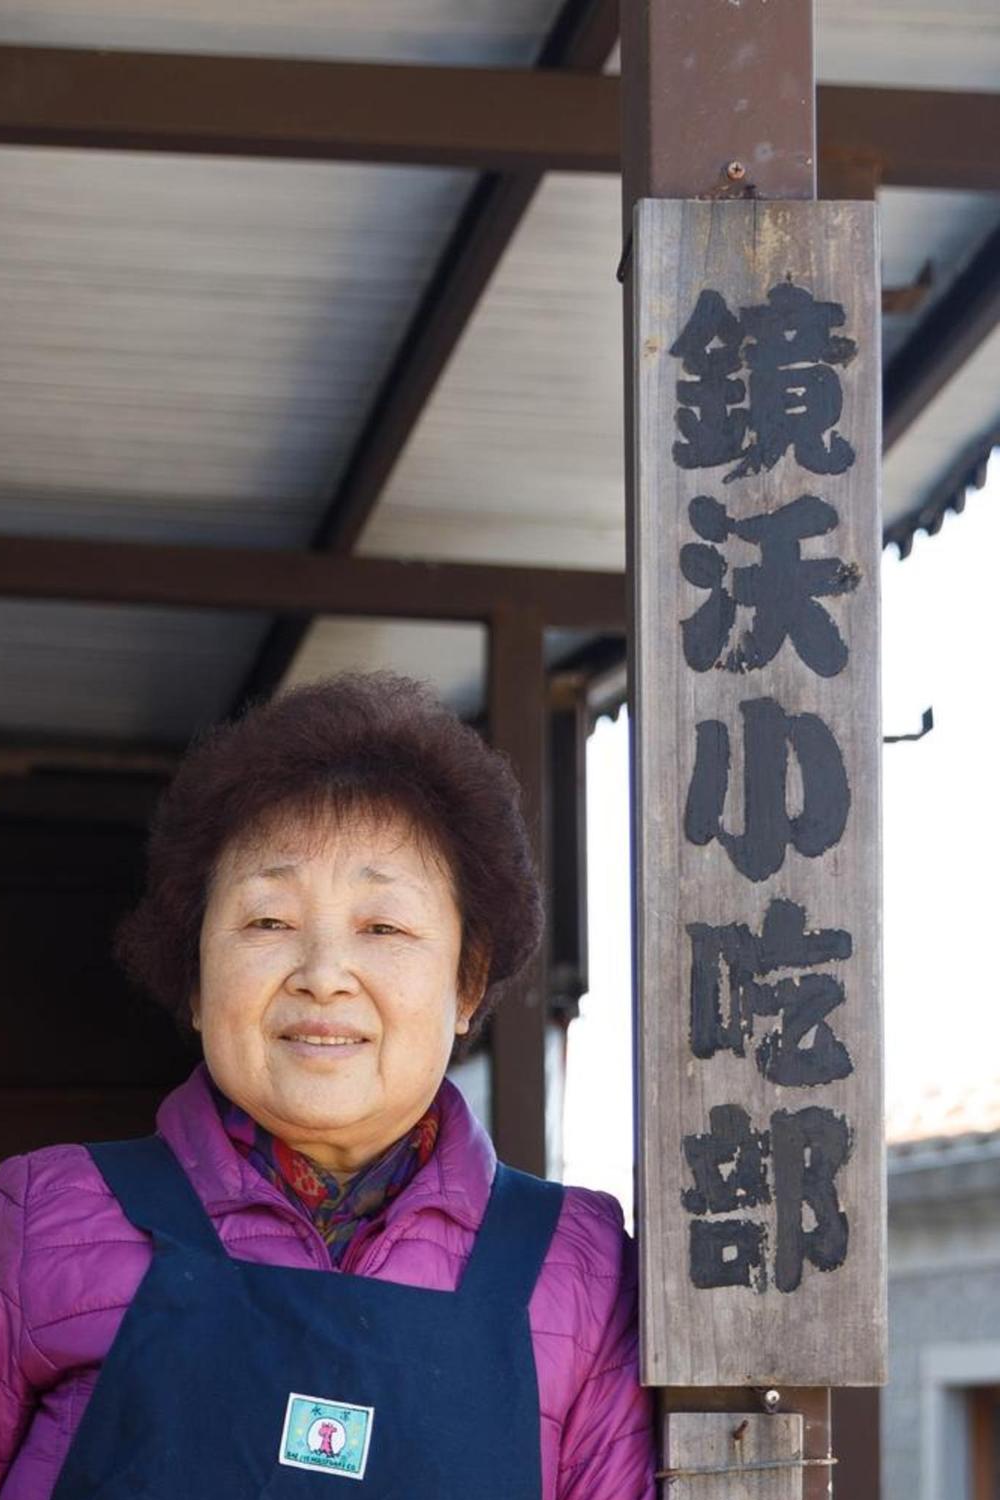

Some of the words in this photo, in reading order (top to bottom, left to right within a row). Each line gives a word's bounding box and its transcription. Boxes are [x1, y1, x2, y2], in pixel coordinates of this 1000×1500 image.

[670, 285, 862, 1297] 鏡沃小吃部
